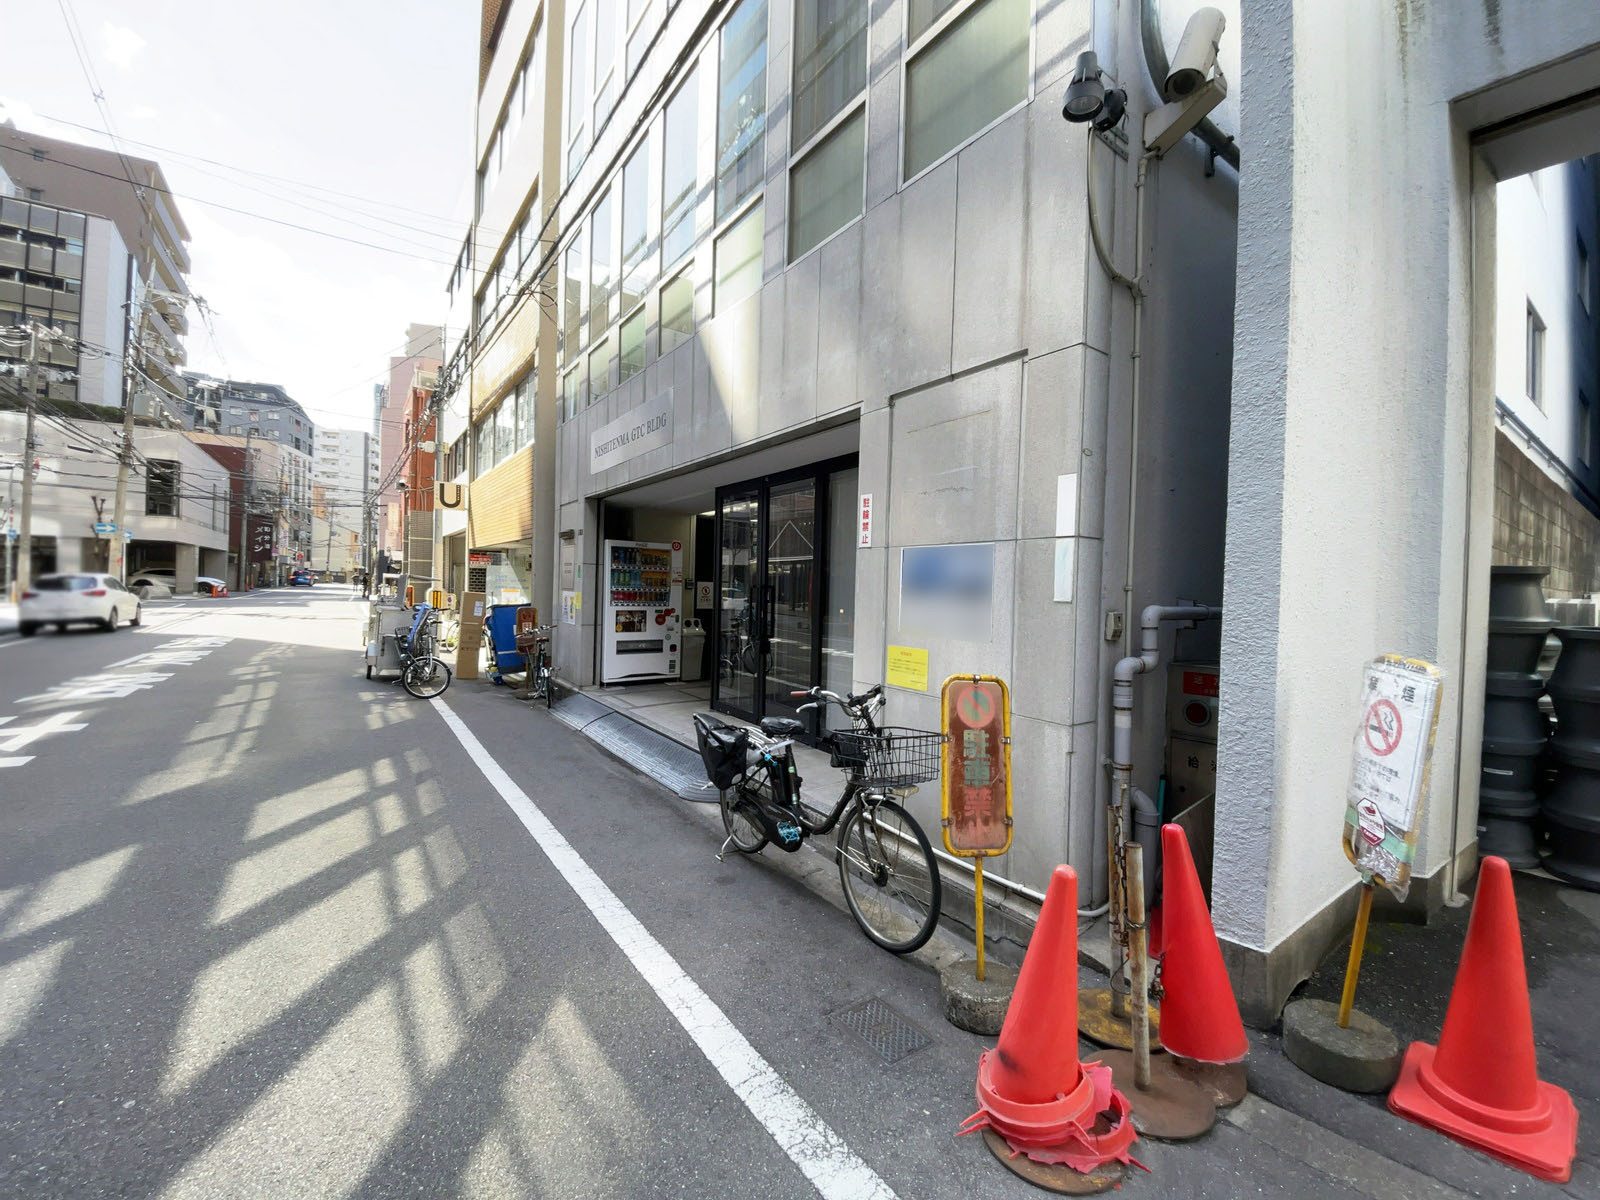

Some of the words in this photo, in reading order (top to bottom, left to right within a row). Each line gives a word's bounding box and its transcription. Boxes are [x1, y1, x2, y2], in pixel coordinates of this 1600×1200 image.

[594, 432, 630, 459] NISHITENMA
[631, 423, 646, 442] GTC
[647, 412, 667, 435] BLDG
